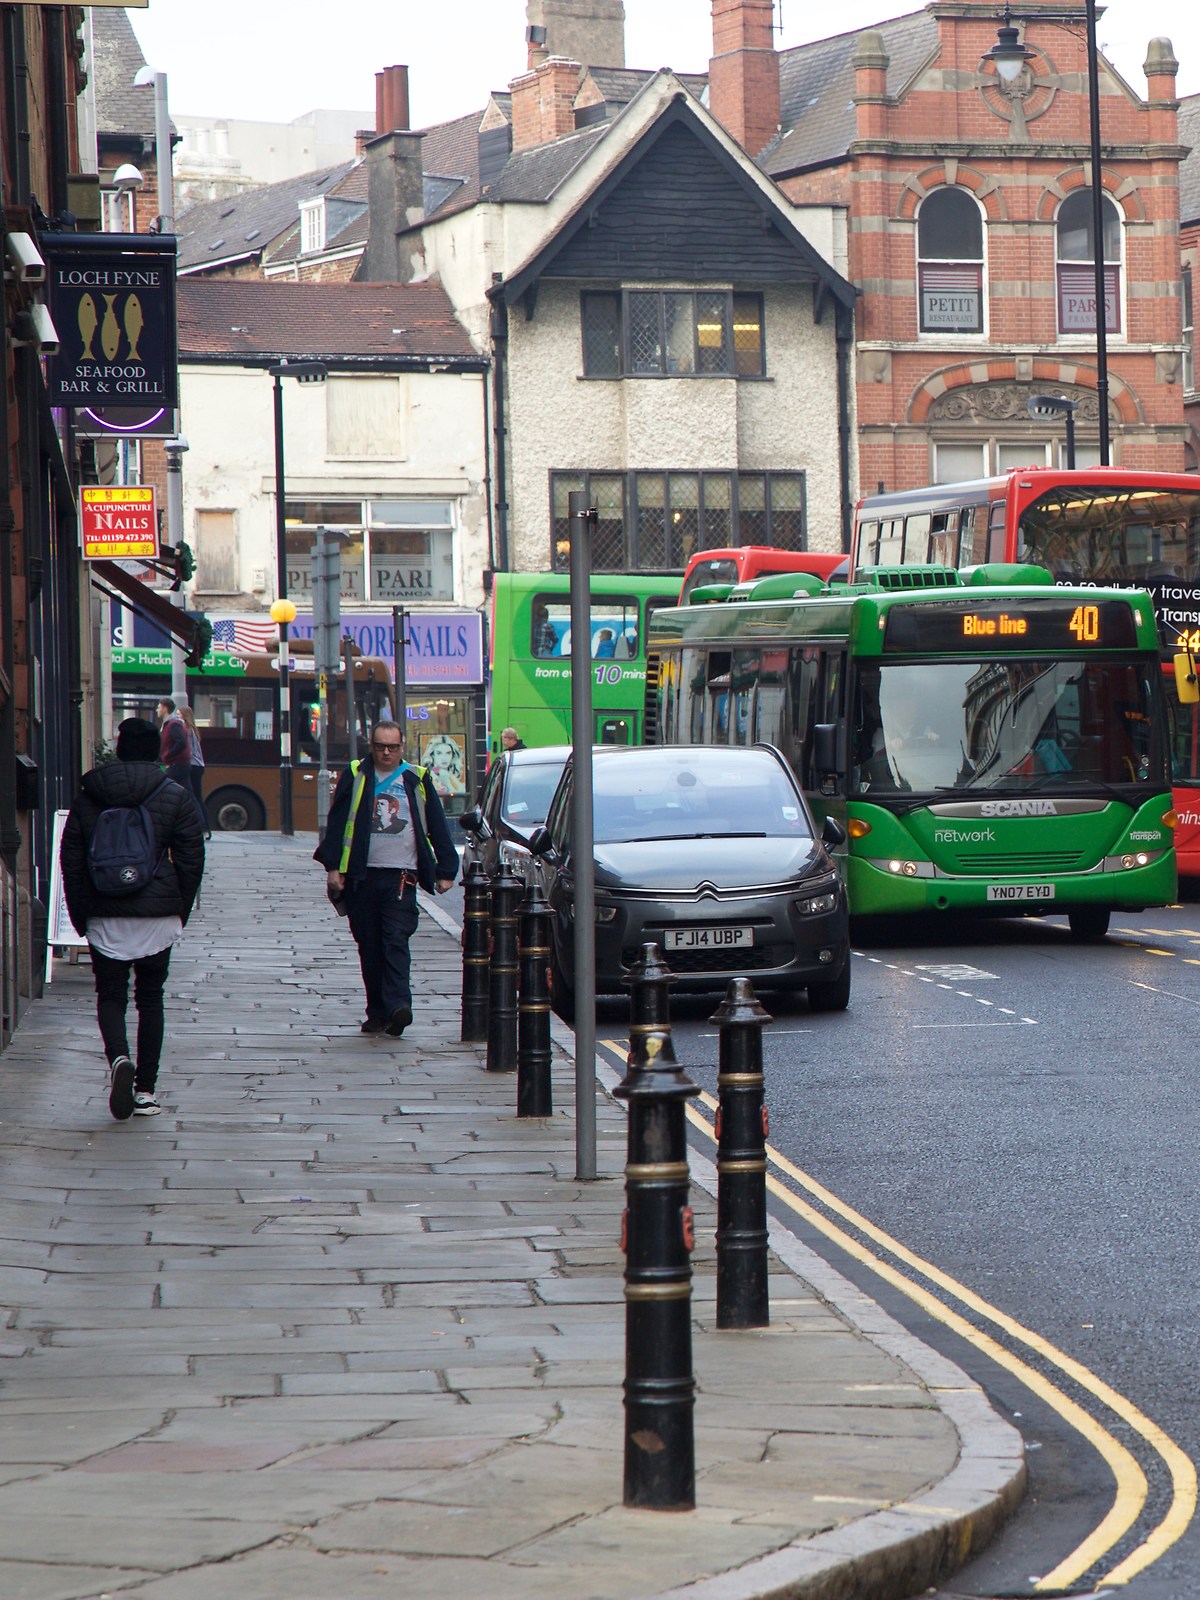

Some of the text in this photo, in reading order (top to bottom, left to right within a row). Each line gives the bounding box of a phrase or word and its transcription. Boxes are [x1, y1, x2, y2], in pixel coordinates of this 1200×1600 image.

[59, 271, 160, 286] LOCH FYNE
[929, 298, 974, 312] PETIT
[1068, 298, 1110, 312] PARS
[929, 314, 974, 323] RESTAURANT
[76, 366, 146, 378] SEAFOOD
[60, 380, 162, 393] BAR & GRILL
[85, 503, 152, 512] ACUPUNCTURE
[94, 513, 149, 530] NAILS
[126, 534, 139, 542] 473
[140, 533, 154, 541] 390
[963, 615, 1027, 635] Blue line
[1069, 605, 1100, 642] 40
[409, 625, 467, 657] NAILS
[228, 656, 250, 670] City
[535, 667, 560, 678] from
[595, 664, 623, 685] 10
[622, 668, 647, 680] mins
[980, 801, 1057, 817] SCANIA
[934, 827, 996, 842] network
[1129, 832, 1162, 841] Transport
[992, 886, 1050, 899] YN07 EYD
[675, 930, 743, 946] FJ14 UBP
